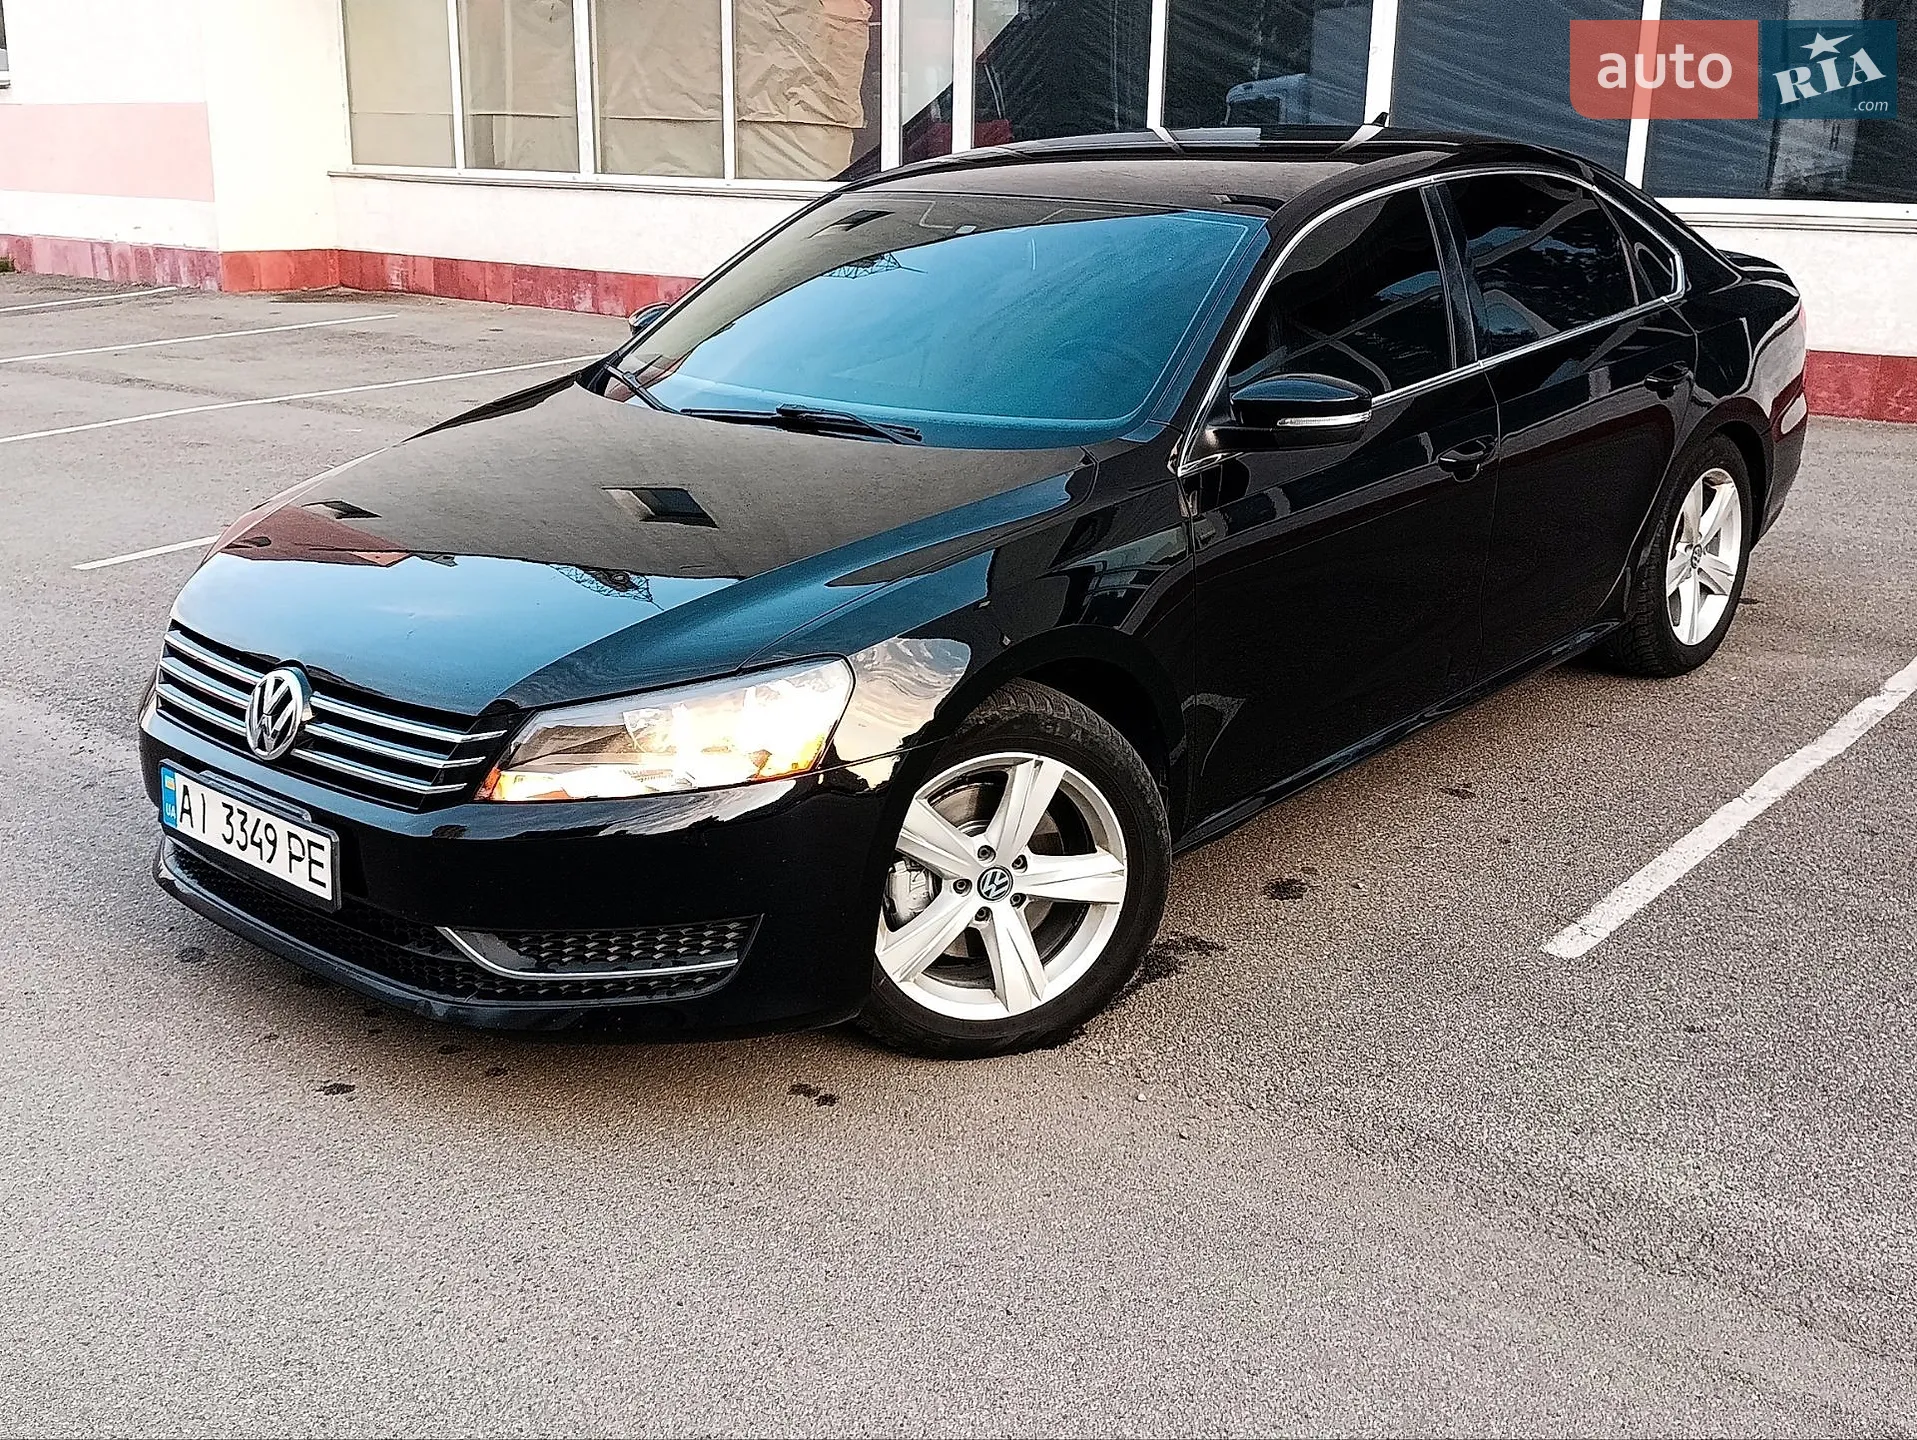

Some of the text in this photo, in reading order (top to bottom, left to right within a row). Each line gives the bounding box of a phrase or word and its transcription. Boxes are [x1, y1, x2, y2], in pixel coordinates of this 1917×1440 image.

[165, 802, 176, 819] UA
[179, 784, 327, 889] AI 3349 PE
